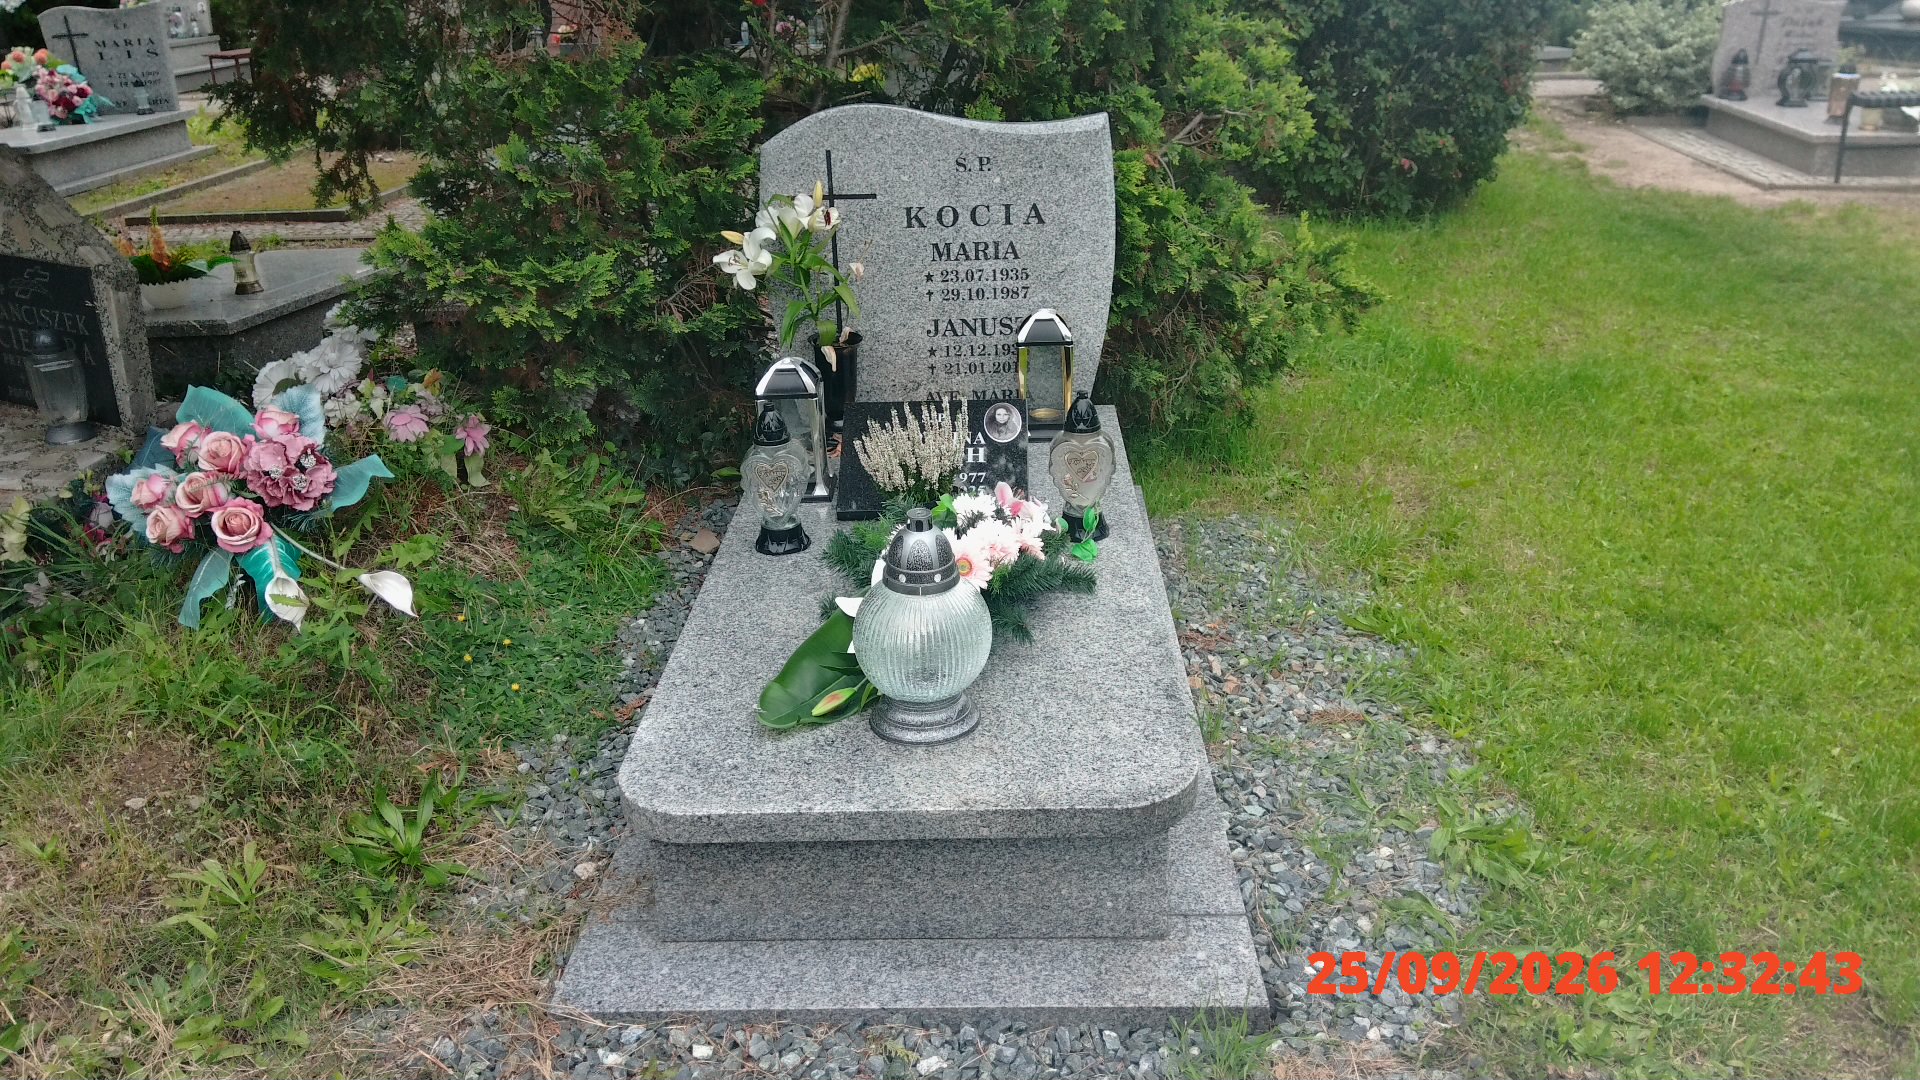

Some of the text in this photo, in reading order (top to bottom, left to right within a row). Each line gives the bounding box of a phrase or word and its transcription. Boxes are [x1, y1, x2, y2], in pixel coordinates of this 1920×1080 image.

[903, 202, 1046, 229] KOCIA
[930, 240, 1022, 262] MARIA
[940, 268, 1031, 284] 23.07.1935
[941, 286, 1030, 301] 29.10.1987
[944, 361, 1020, 376] 21.01.201
